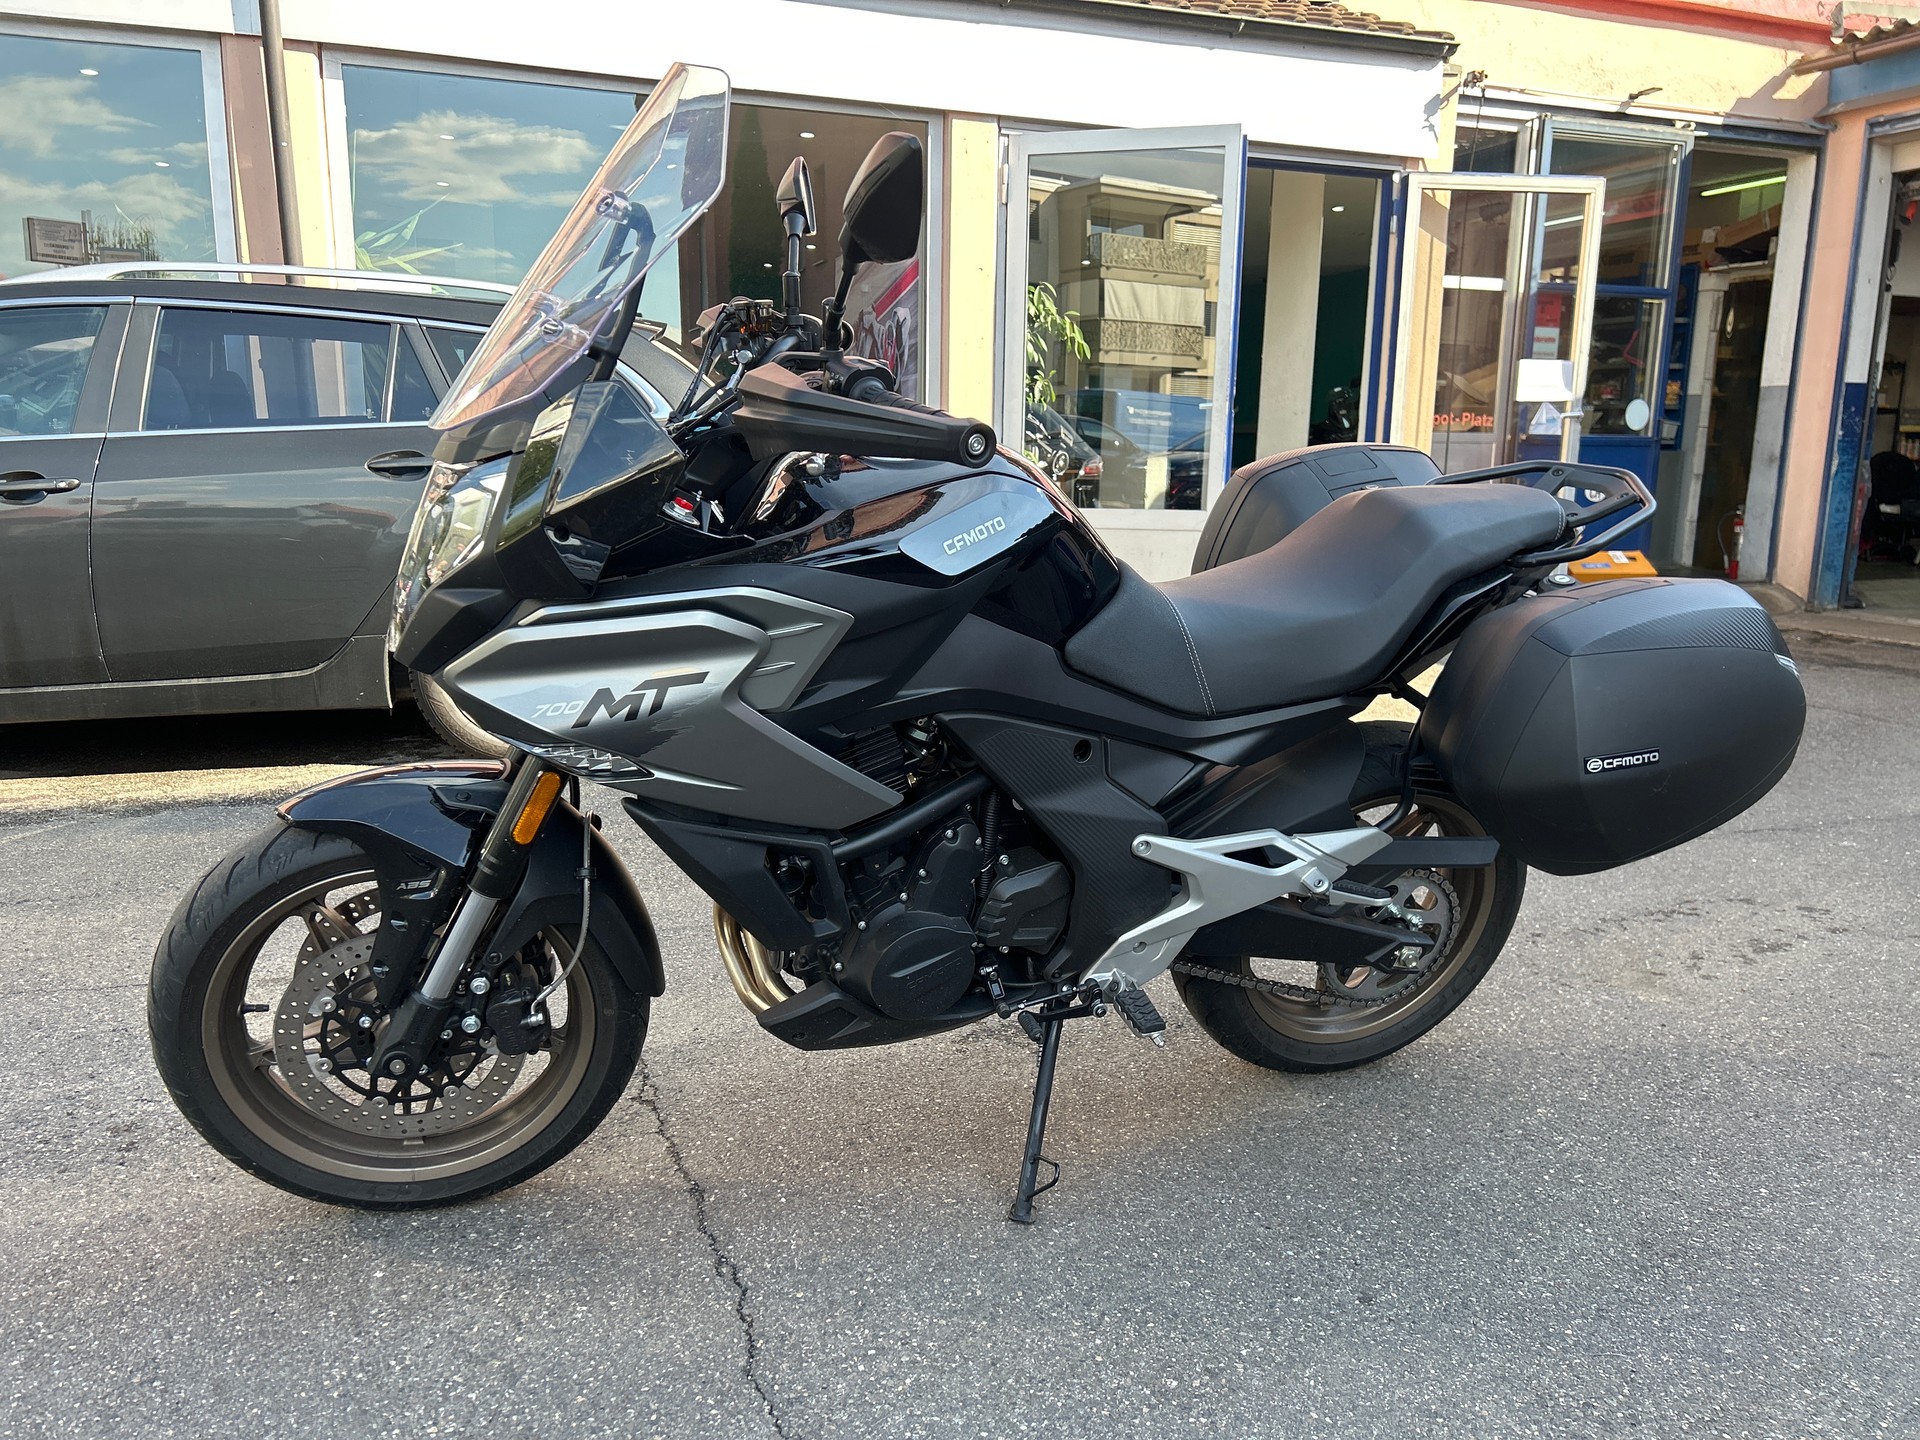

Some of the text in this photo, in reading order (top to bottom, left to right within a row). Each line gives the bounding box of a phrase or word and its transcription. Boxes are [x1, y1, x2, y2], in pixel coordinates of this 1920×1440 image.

[943, 516, 1006, 555] CFMOTO
[531, 671, 710, 729] 700 MT
[1603, 752, 1659, 768] CFMOTO
[396, 880, 432, 890] ABS
